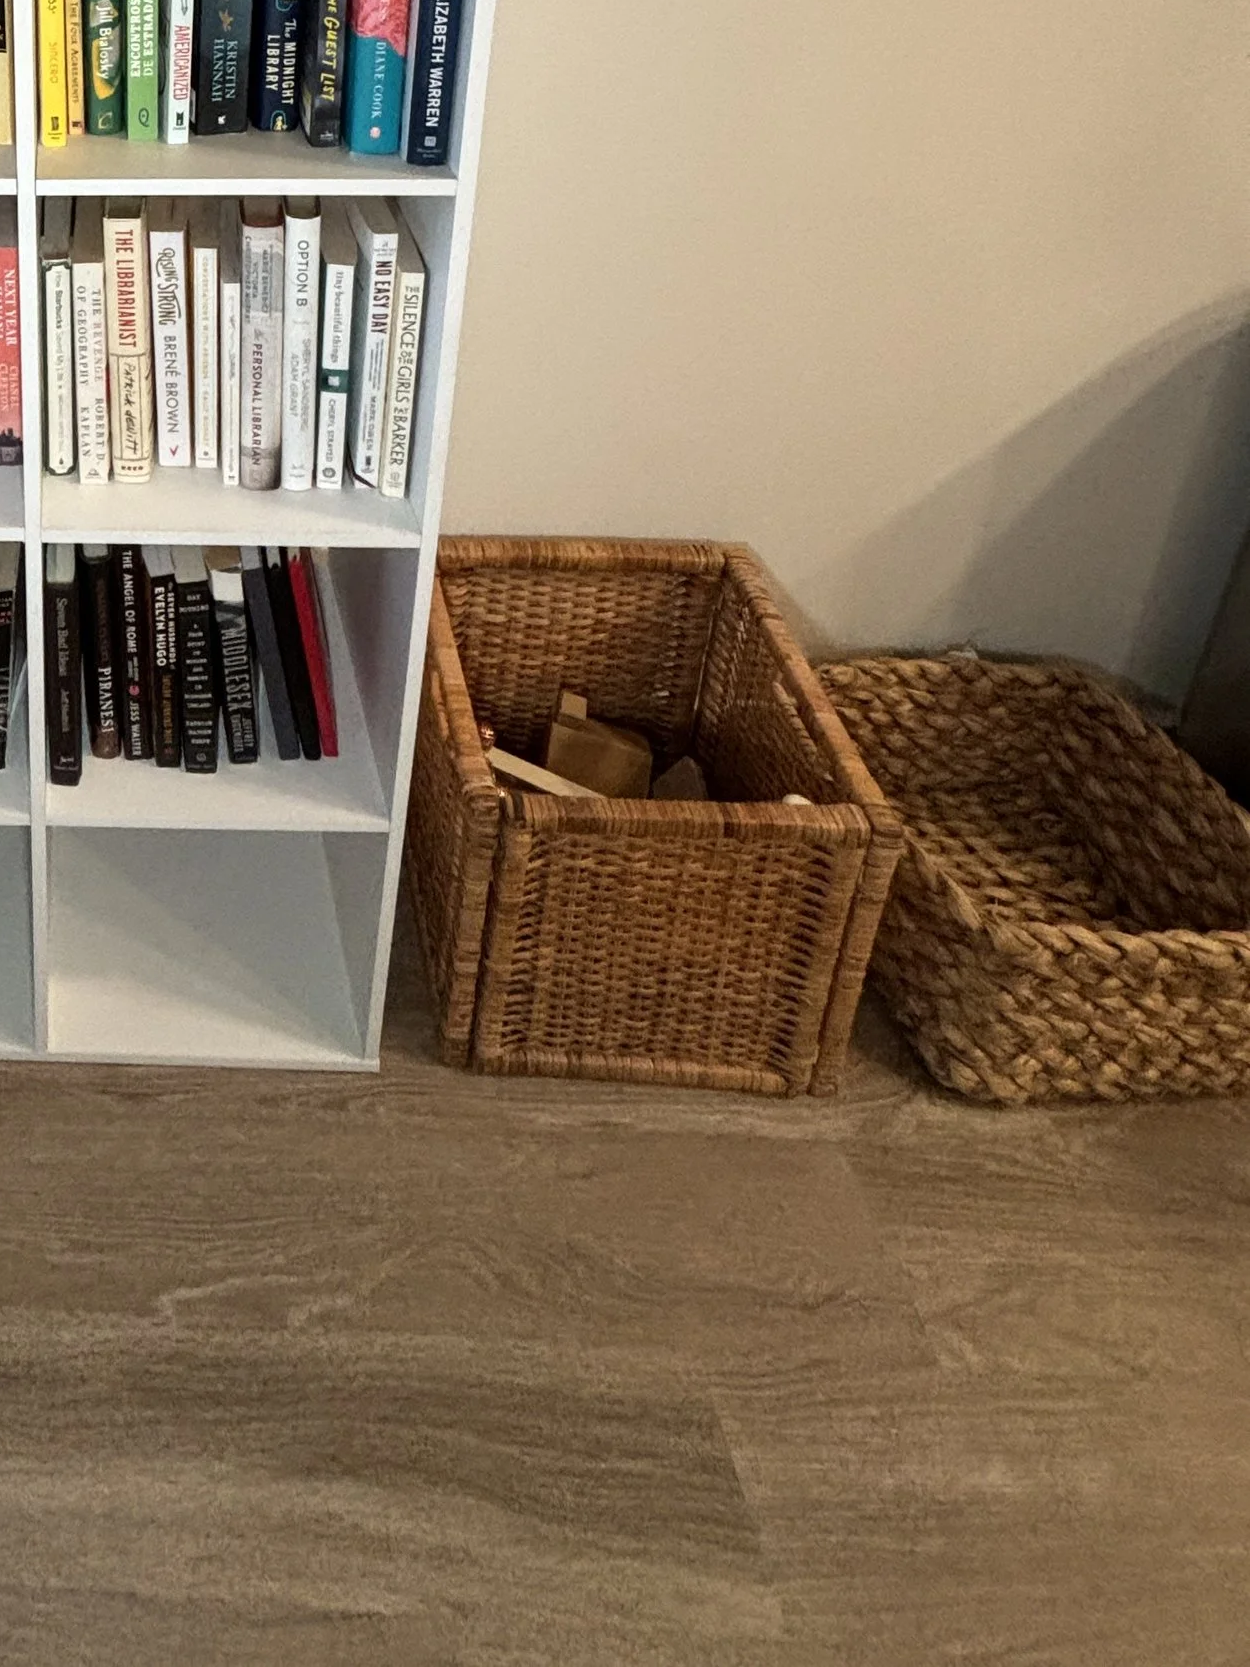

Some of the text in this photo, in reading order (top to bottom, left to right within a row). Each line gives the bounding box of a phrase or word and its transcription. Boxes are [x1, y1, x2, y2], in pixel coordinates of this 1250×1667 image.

[71, 21, 80, 45] FOUR
[96, 23, 113, 80] Bialosky
[321, 15, 340, 71] GUEST
[373, 41, 387, 81] DIANE
[47, 40, 58, 84] SINCERO
[143, 60, 154, 76] DE
[172, 23, 190, 101] AMERICANIZED
[211, 38, 225, 103] HANNAH
[224, 39, 239, 100] KRISTIN
[264, 33, 281, 91] LIBRARY
[281, 41, 300, 105] MIDNIGHT
[319, 73, 335, 102] LIST
[425, 66, 445, 128] WARREN
[114, 229, 137, 349] THE LIBRARIANIST
[296, 240, 309, 307] OPTION B
[373, 279, 391, 310] EASY
[376, 261, 392, 276] NO
[4, 268, 17, 347] NEXT YEAR
[54, 289, 63, 329] Starbucks
[77, 286, 89, 386] OF GEOGRAPHY
[92, 288, 104, 383] THE REVENGE
[330, 292, 344, 364] beautiful things
[370, 313, 389, 334] DAY
[123, 362, 135, 406] Patrick
[252, 343, 262, 404] PERSONAL
[390, 294, 419, 466] SILENCE GIRLS BARKER
[165, 381, 179, 434] BROWN
[252, 406, 262, 466] LIBRARIAN
[369, 396, 377, 421] MARK
[122, 550, 133, 570] THE
[123, 573, 136, 608] ANGEL
[125, 609, 136, 623] OF
[126, 625, 137, 654] ROME
[154, 586, 167, 666] EVELYN HUGO
[221, 623, 252, 712] MIDDLESEX
[98, 666, 115, 733] PIRANESI
[130, 701, 142, 756] JESS WALTER
